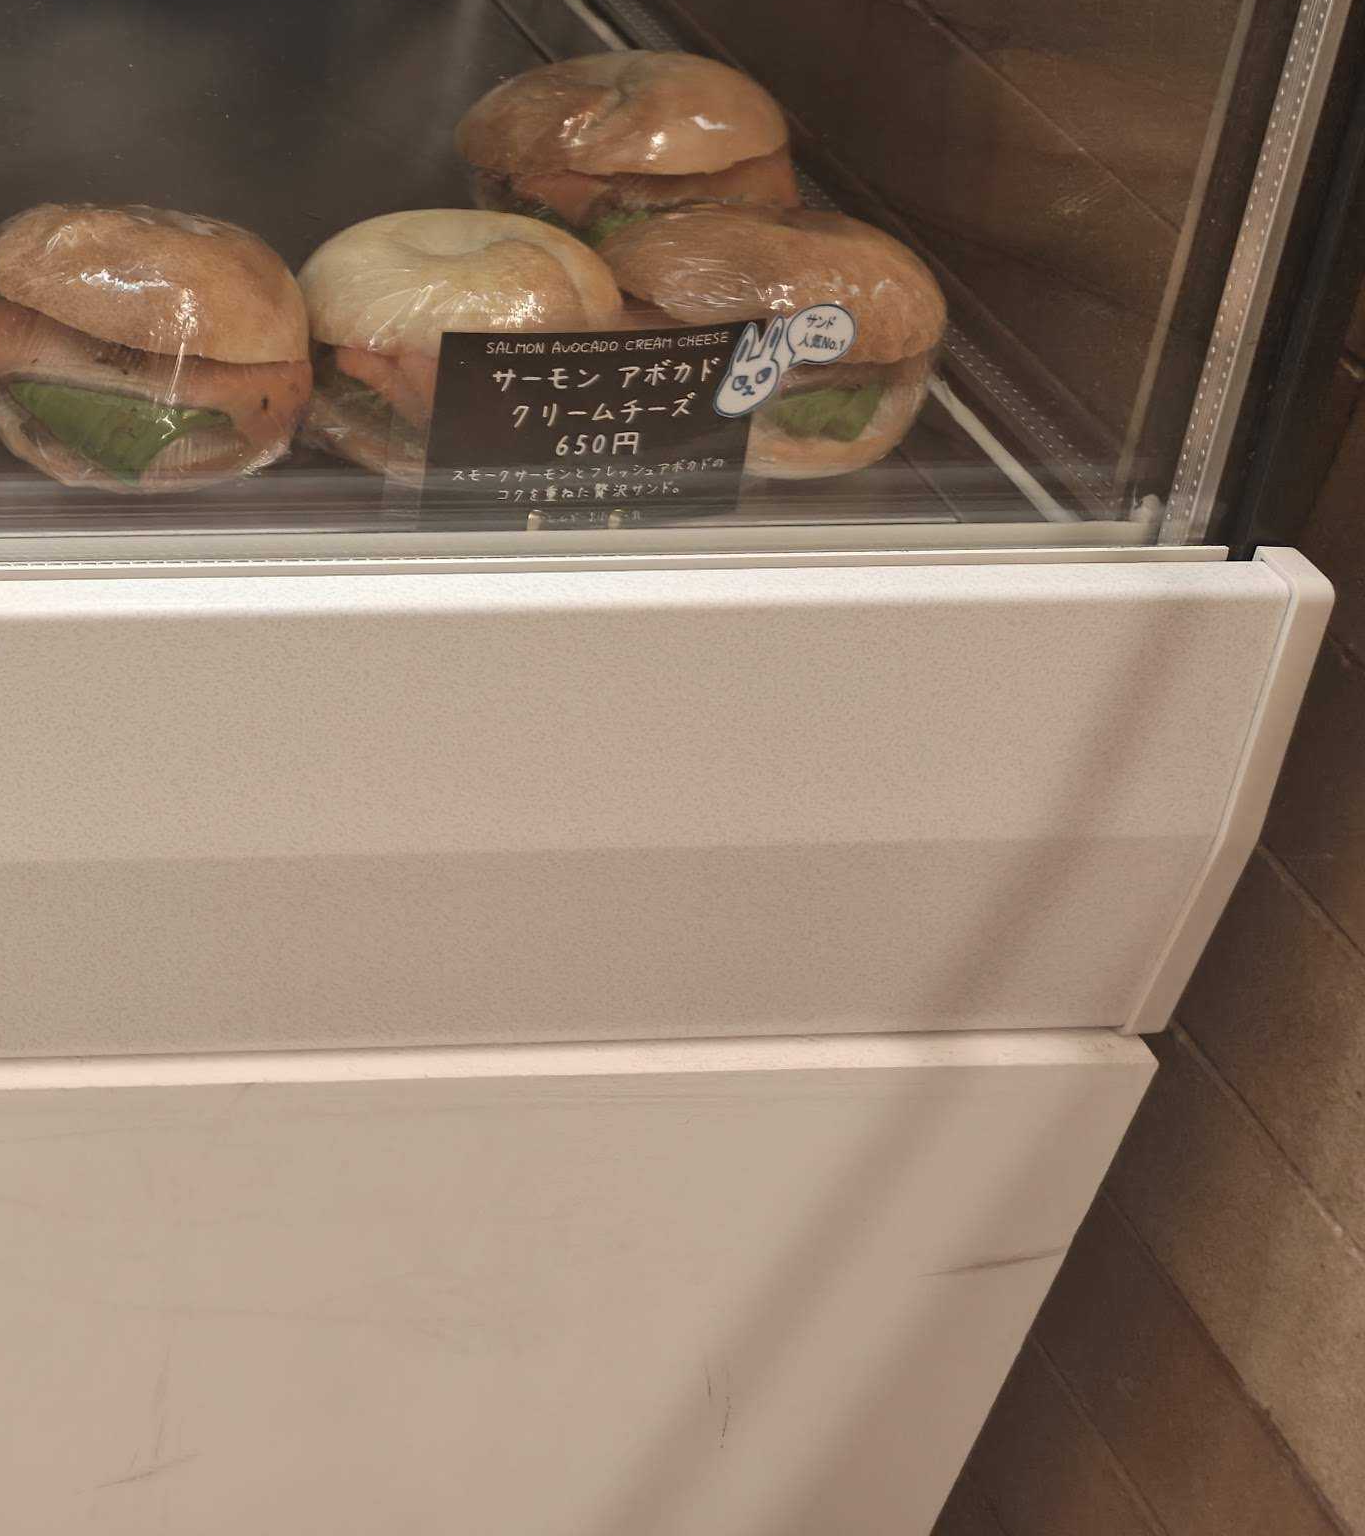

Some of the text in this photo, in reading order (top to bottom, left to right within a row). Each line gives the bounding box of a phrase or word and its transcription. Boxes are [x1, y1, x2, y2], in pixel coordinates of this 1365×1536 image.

[486, 331, 729, 355] SALMON AVOCADO CREAM CHEESE
[492, 357, 720, 392] サーモン アボカド
[512, 392, 697, 429] クリームチーズ
[556, 431, 640, 457] 650円
